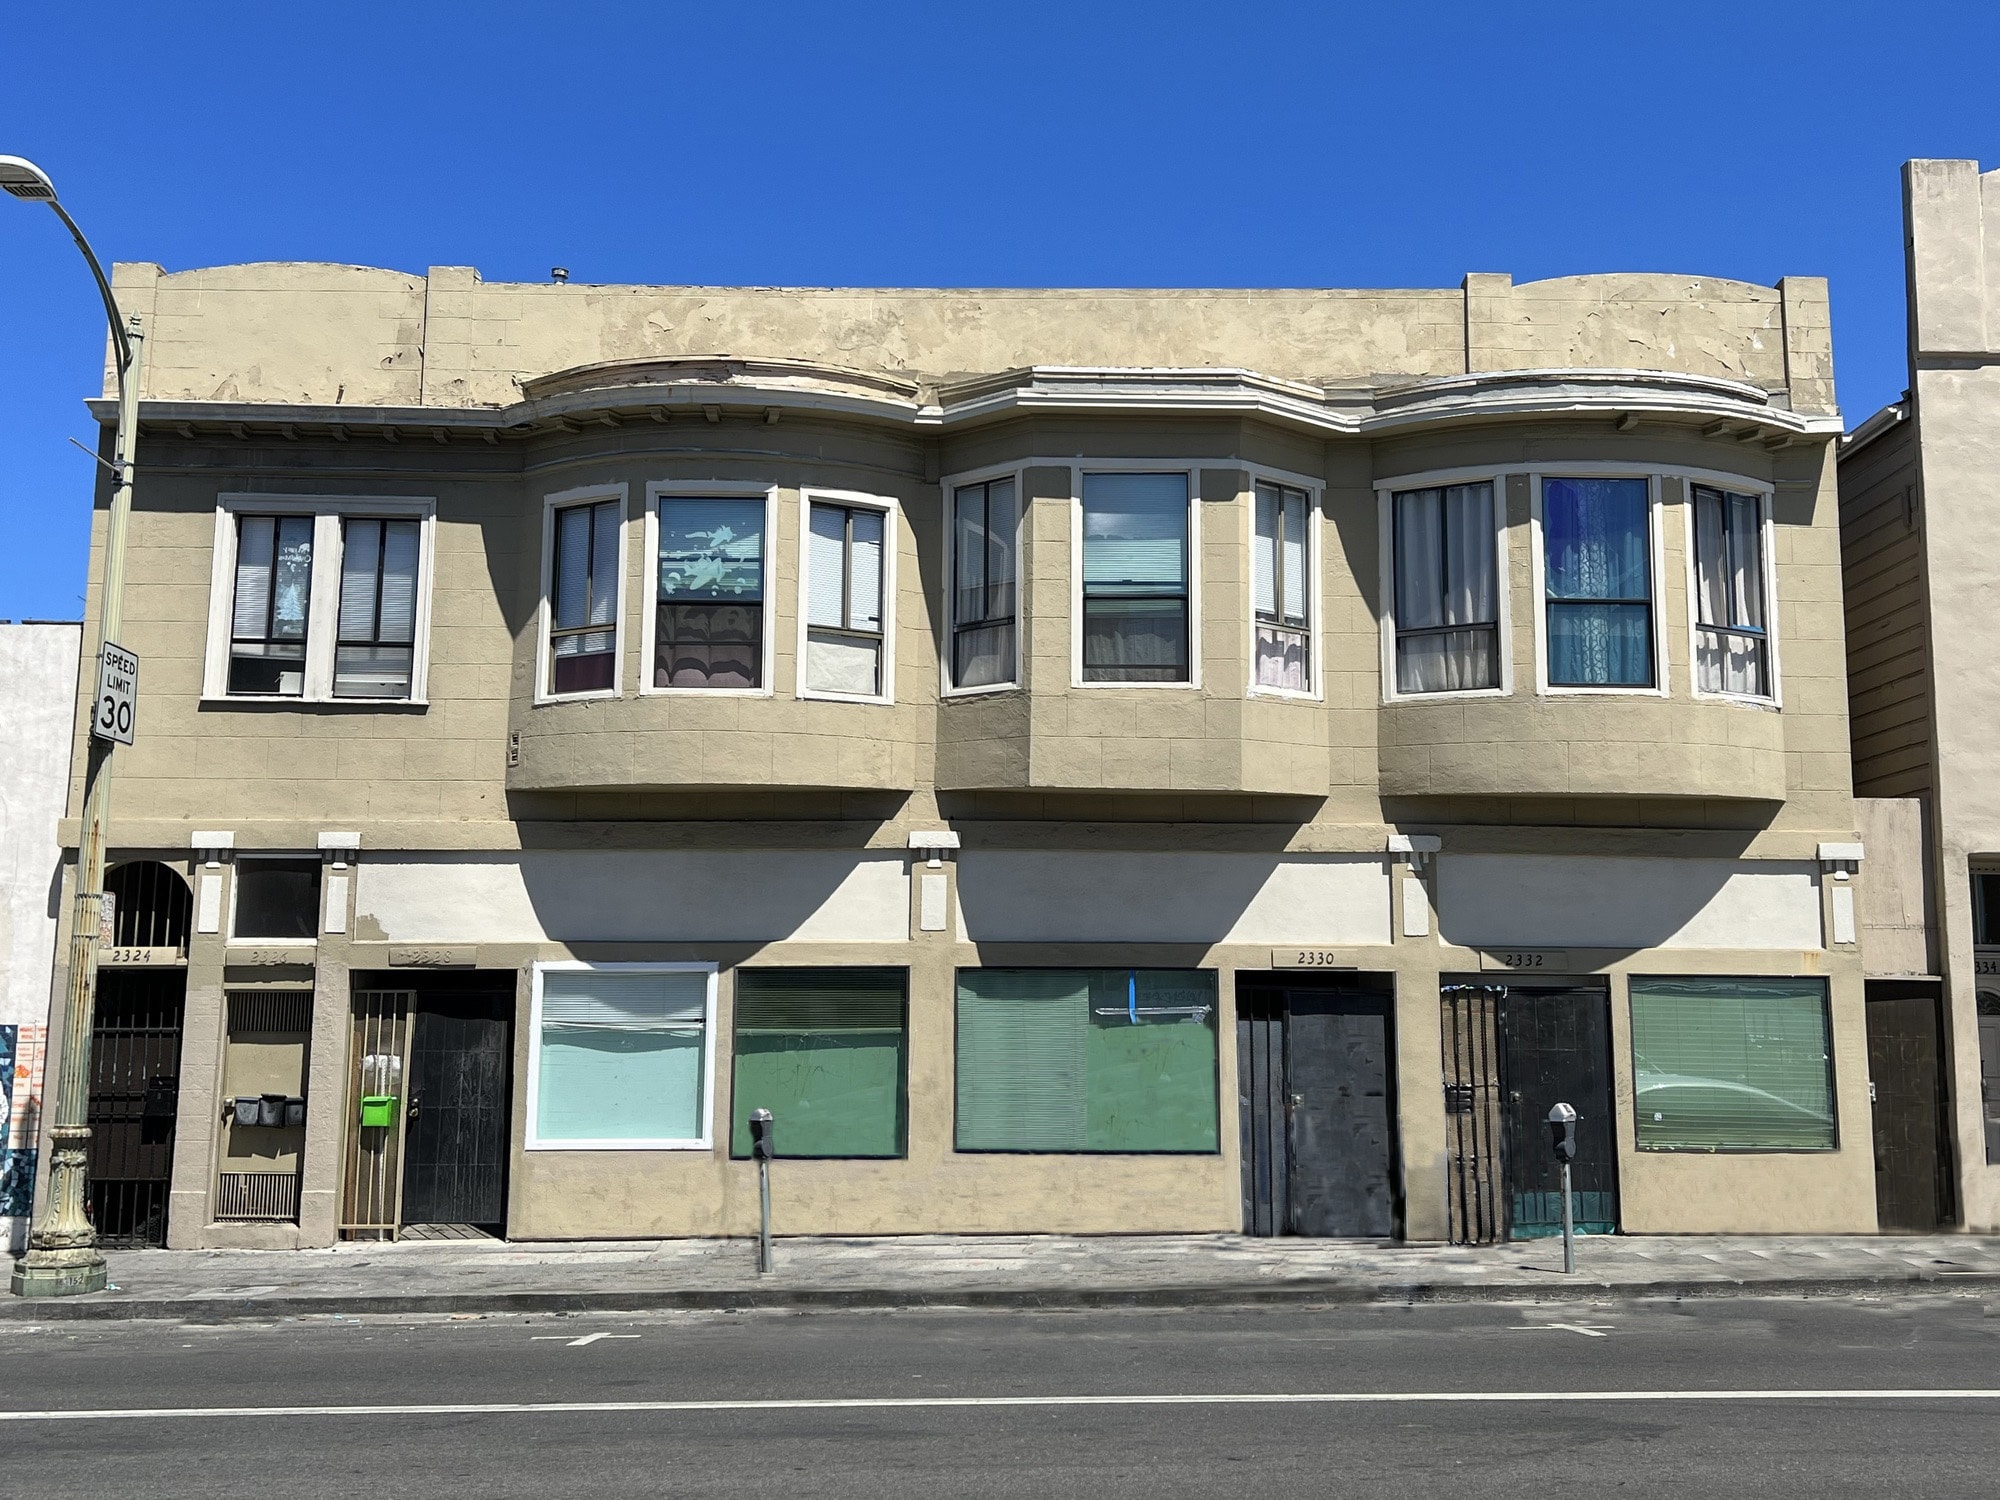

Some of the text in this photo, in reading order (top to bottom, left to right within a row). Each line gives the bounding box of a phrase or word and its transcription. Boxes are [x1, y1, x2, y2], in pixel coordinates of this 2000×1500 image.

[105, 652, 135, 675] SPEED
[107, 674, 131, 694] LIMIT
[101, 695, 131, 734] 30
[112, 949, 151, 963] 2324
[250, 951, 289, 964] 2326
[411, 950, 452, 964] 2328
[1298, 952, 1334, 965] 2330
[1505, 954, 1543, 967] 2332
